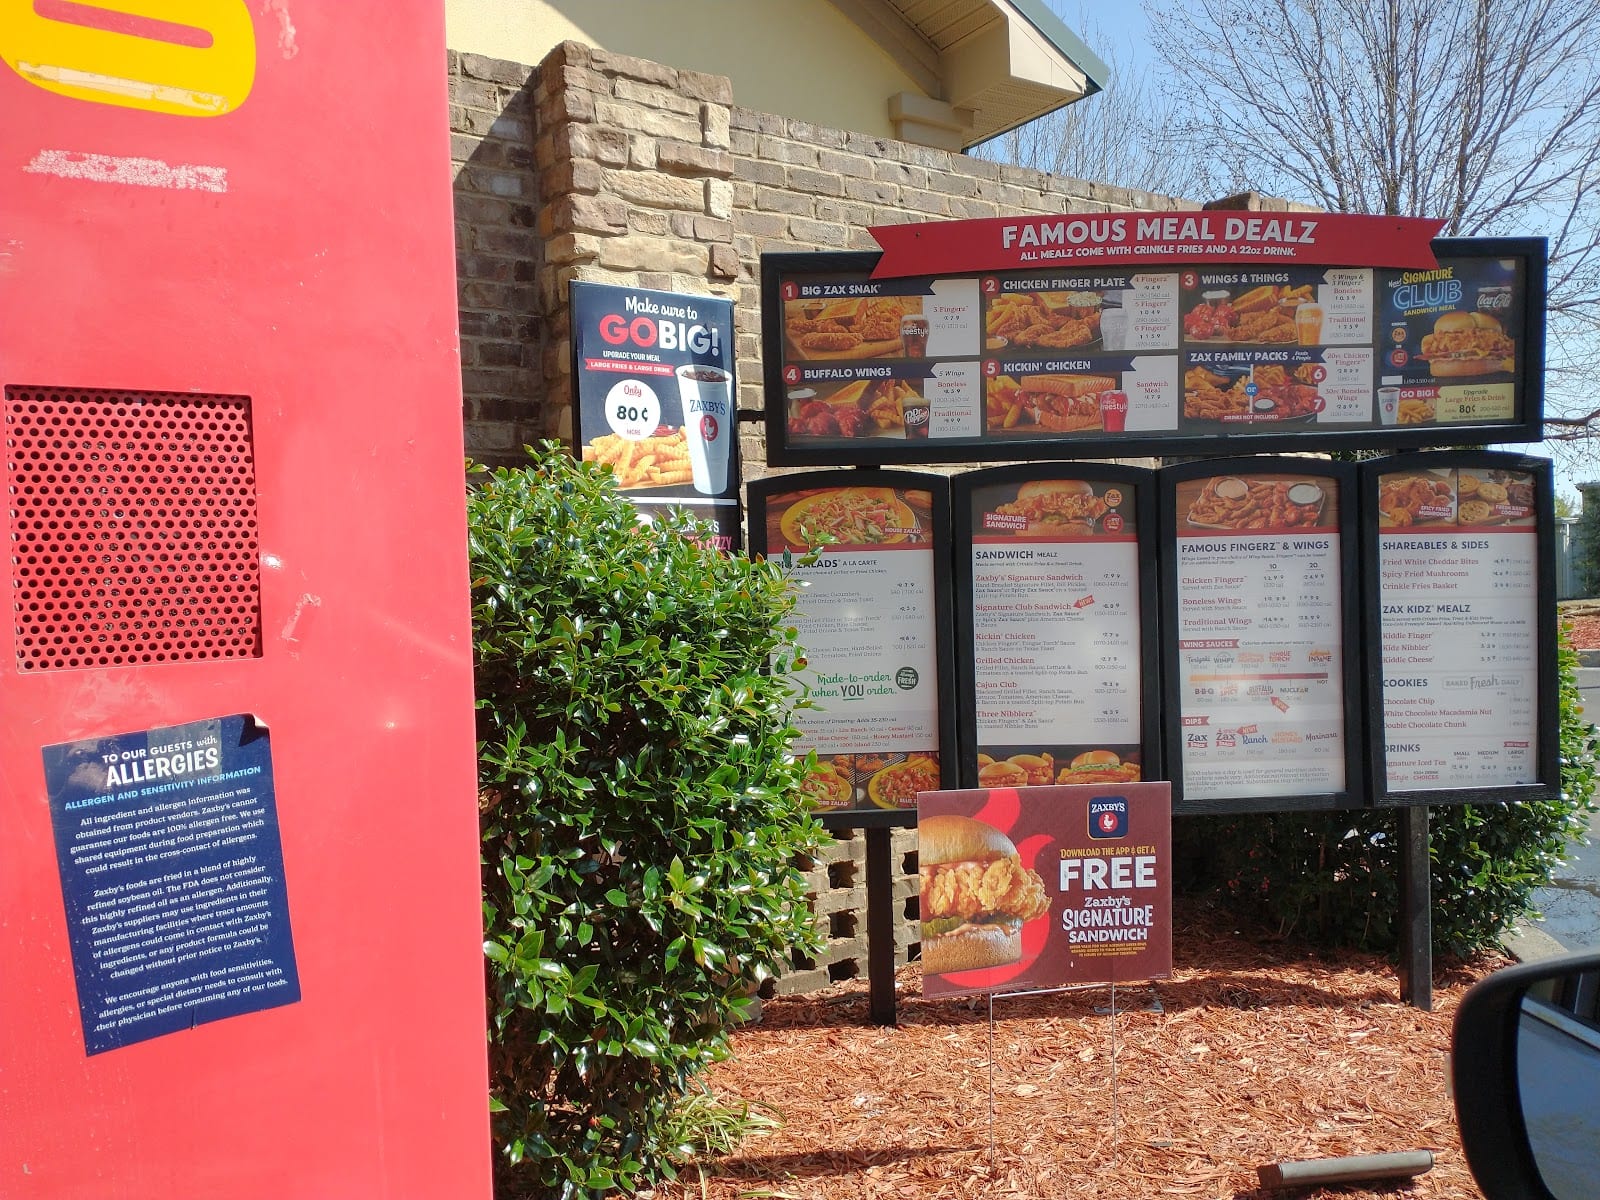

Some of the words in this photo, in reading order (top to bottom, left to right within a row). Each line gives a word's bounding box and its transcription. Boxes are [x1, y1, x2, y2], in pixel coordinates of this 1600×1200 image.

[1002, 218, 1126, 248] FAMOUS
[1136, 218, 1215, 240] MEAL
[1224, 218, 1318, 243] DEALZ
[1020, 252, 1038, 261] ALL
[1040, 249, 1073, 259] MEALZ
[1076, 248, 1104, 256] COME
[1107, 247, 1131, 255] WITH
[1134, 245, 1174, 254] CRINKLE
[1177, 245, 1203, 254] FRIES
[1206, 245, 1227, 254] AND
[1230, 246, 1237, 254] A
[1240, 246, 1261, 254] 22oz
[1263, 247, 1296, 256] DRINK.
[1185, 275, 1193, 285] 3
[1202, 274, 1238, 284] WINGS
[1242, 274, 1248, 282] &
[1250, 274, 1288, 282] THINGS
[1403, 267, 1453, 284] SIGNATURE
[986, 280, 996, 291] 2
[1003, 279, 1049, 290] CHICKEN
[1052, 278, 1090, 288] FINGER
[1094, 278, 1125, 287] PLATE
[786, 286, 792, 297] 1
[802, 286, 821, 295] BIG
[824, 285, 846, 295] ZAX
[1393, 279, 1462, 309] CLUB
[625, 296, 659, 314] Make
[661, 305, 685, 319] sure
[687, 306, 697, 320] to
[1404, 307, 1438, 316] SANDWICH
[603, 351, 630, 359] UPGRADE
[631, 352, 645, 361] YOUR
[646, 354, 660, 362] MEAL
[1191, 353, 1211, 362] ZAX
[1215, 353, 1252, 361] FAMILY
[1255, 352, 1288, 360] PACKS
[987, 363, 996, 374] 5
[1004, 362, 1043, 372] KICKIN'
[1046, 361, 1090, 370] CHICKEN
[787, 369, 796, 380] 4
[805, 368, 853, 379] BUFFALO
[855, 368, 891, 377] WINGS
[1314, 370, 1322, 379] 6
[624, 385, 642, 397] Only
[690, 400, 725, 415] ZAXBY'S
[1314, 400, 1321, 410] 7
[986, 514, 1027, 523] SIGNATURE
[1182, 544, 1226, 553] FAMOUS
[1282, 542, 1289, 550] &
[1293, 541, 1329, 549] WINGS
[1383, 542, 1447, 550] SHAREABLES
[1462, 541, 1489, 549] SIDES
[976, 551, 1033, 559] SANDWICH
[1383, 605, 1403, 613] ZAX
[817, 671, 891, 685] Made-to-order
[1383, 678, 1428, 688] COOKIES
[1470, 675, 1499, 690] Fresh
[812, 688, 839, 697] when
[841, 685, 864, 697] YOU
[867, 685, 897, 695] order.
[1242, 736, 1268, 745] Ranch
[1306, 732, 1337, 741] Marinara
[102, 754, 118, 763] TO
[122, 749, 146, 760] OUR
[150, 741, 192, 754] GUESTS
[197, 735, 217, 746] with
[107, 748, 218, 787] ALLERGIES
[65, 794, 114, 810] ALLERGEN
[118, 791, 138, 800] AND
[141, 780, 194, 796] SENSITIVITY
[198, 766, 260, 785] INFORMATION
[80, 818, 92, 826] All
[95, 810, 136, 822] ingredient
[138, 806, 153, 814] and
[155, 800, 186, 812] allergen
[189, 791, 234, 804] information
[1092, 802, 1125, 813] ZAXBY'S
[76, 826, 111, 839] obtained
[113, 823, 133, 831] from
[135, 816, 165, 828] product
[168, 810, 200, 820] vendors.
[202, 803, 230, 814] Zaxby's
[232, 798, 258, 808] cannot
[70, 840, 112, 854] guarantee
[130, 831, 150, 840] foods
[167, 824, 187, 832] 100%
[189, 818, 220, 828] allergen
[221, 814, 238, 822] free.
[1060, 848, 1100, 858] DOWNLOAD
[1102, 847, 1114, 855] THE
[1116, 846, 1129, 855] APP
[1131, 846, 1135, 855] &
[1137, 846, 1150, 854] GET
[1060, 856, 1156, 891] FREE
[1084, 896, 1131, 908] Zaxby's
[1063, 905, 1153, 930] SIGNATURE
[1069, 928, 1147, 943] SANDWICH
